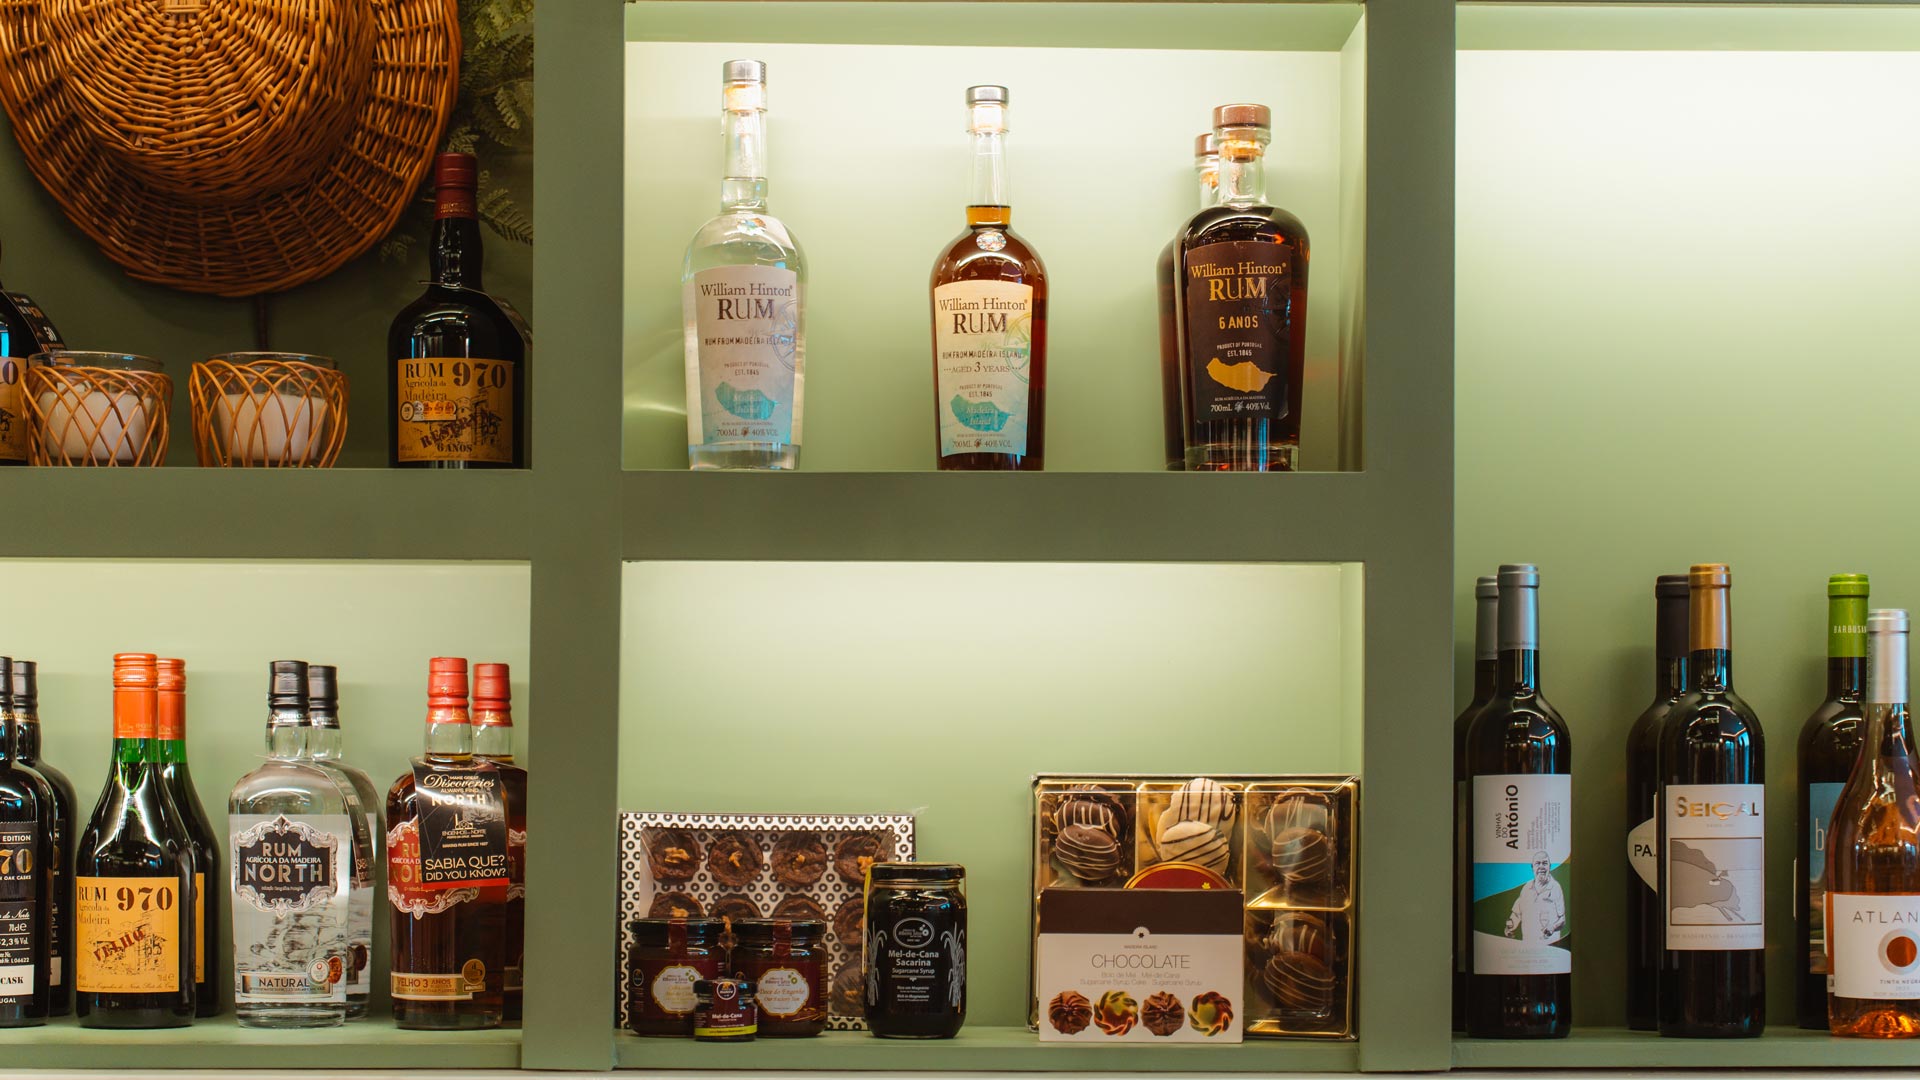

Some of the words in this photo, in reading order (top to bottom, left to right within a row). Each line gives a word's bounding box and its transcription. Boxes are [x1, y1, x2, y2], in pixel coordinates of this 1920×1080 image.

[1191, 263, 1234, 278] William
[701, 283, 746, 296] William
[1209, 277, 1267, 301] RUM
[717, 298, 774, 320] RUM
[940, 298, 979, 311] William
[952, 313, 1008, 334] RUM
[1219, 316, 1225, 329] 6
[1228, 316, 1258, 328] ANOS
[974, 362, 980, 372] 3
[406, 363, 444, 378] RUM
[452, 362, 506, 389] 970
[405, 389, 447, 400] Madeira
[1246, 402, 1259, 410] 40%
[446, 444, 472, 452] ANOS
[423, 774, 494, 788] Discoveries
[431, 794, 486, 806] NORTH
[1675, 796, 1759, 820] SEIÇAL
[1502, 827, 1508, 838] DO
[262, 843, 302, 856] RUM
[402, 843, 420, 857] RU
[425, 858, 466, 871] SABIA
[468, 855, 505, 869] QUE?
[245, 864, 323, 882] NORTH
[444, 871, 466, 880] YOU
[470, 868, 506, 878] KNOW?
[79, 887, 107, 901] RUM
[116, 887, 172, 911] 970
[888, 950, 939, 958] Mel-de-Cana
[1092, 954, 1191, 968] CHOCOLATE
[1, 976, 24, 984] CASK
[259, 978, 310, 988] NATURAL
[423, 978, 428, 988] 3
